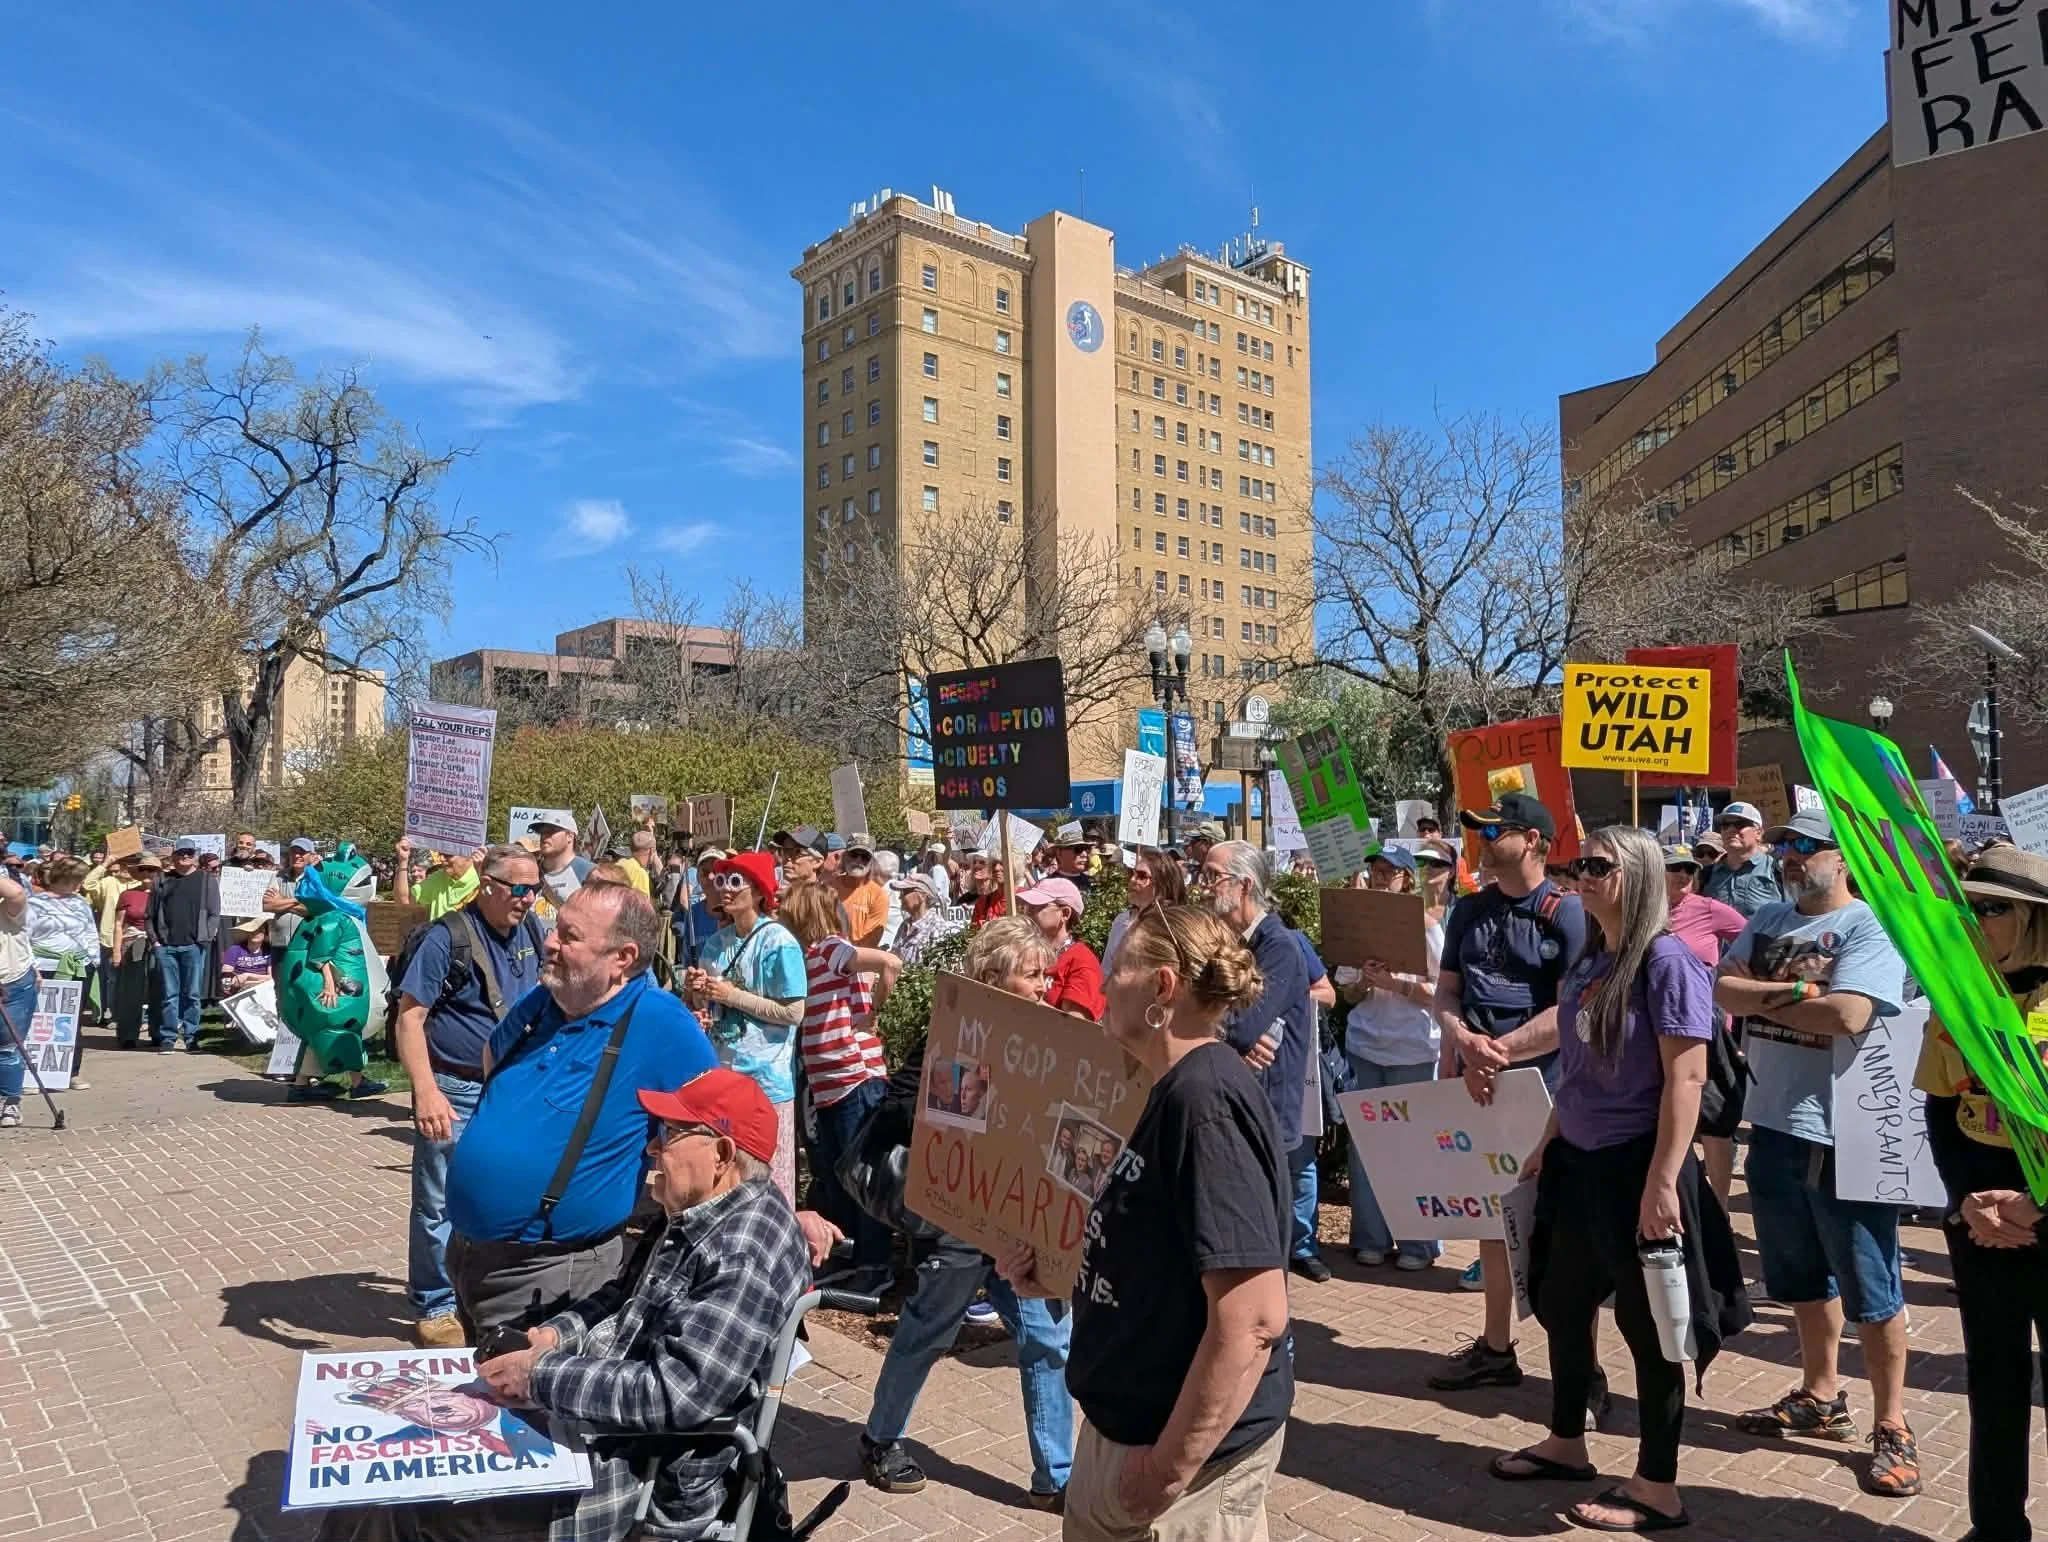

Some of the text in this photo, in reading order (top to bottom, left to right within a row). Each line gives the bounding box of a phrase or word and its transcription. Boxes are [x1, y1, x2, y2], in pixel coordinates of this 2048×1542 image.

[1912, 9, 2048, 98] FE
[1576, 673, 1699, 690] Protect
[1586, 691, 1689, 720] WILD
[411, 716, 492, 737] CALL YOUR REPS
[1580, 723, 1692, 754] UTAH
[944, 743, 1021, 767] CRUELTY
[1456, 727, 1562, 764] QUIET
[1603, 755, 1669, 767] www.suwa.org
[946, 775, 1007, 799] CHAOS
[513, 811, 529, 820] NO
[693, 799, 713, 817] ICE
[957, 1015, 992, 1058] MY
[1004, 1034, 1057, 1086] GOP
[1074, 1058, 1127, 1114] REP
[1360, 1100, 1410, 1122] SAY
[1434, 1130, 1472, 1153] NO
[1482, 1152, 1519, 1175] TO
[926, 1131, 1086, 1250] COWARD
[316, 1361, 384, 1381] NO
[313, 1424, 372, 1446] NO
[309, 1451, 550, 1488] IN AMERICA.
